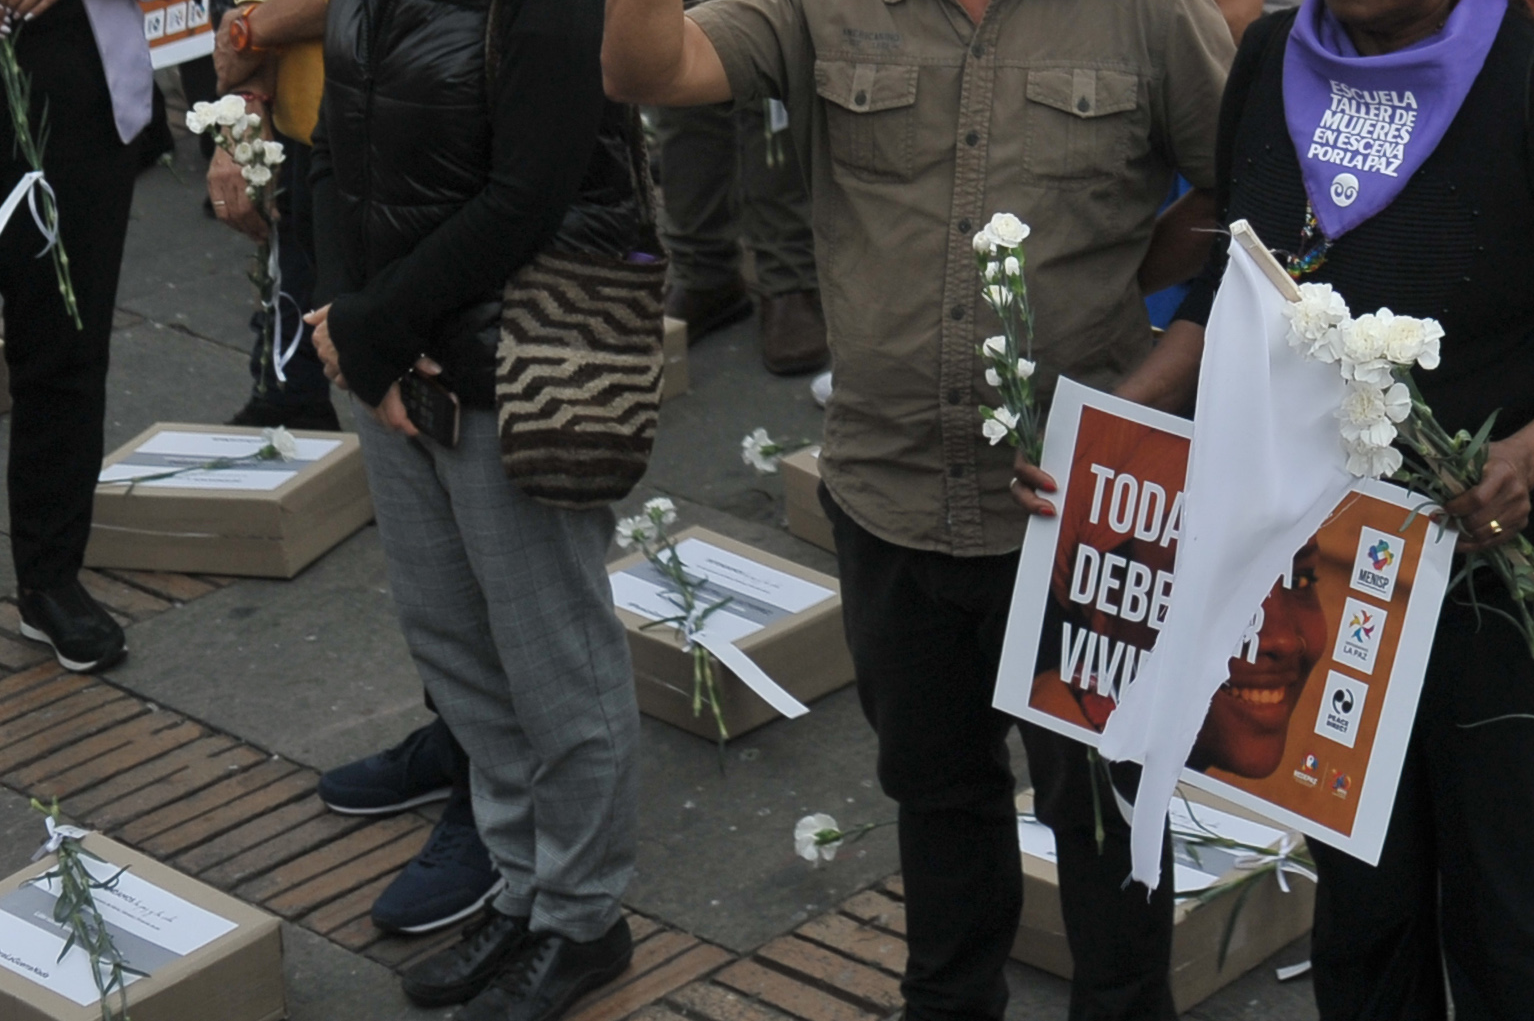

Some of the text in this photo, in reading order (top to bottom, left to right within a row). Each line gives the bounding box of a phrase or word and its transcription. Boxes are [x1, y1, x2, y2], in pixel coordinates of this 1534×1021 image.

[1329, 80, 1418, 109] ESCUELA
[1330, 93, 1417, 127] TALLER DE
[1320, 109, 1413, 144] MUJERES
[1313, 128, 1405, 161] EN ESCENA
[1089, 463, 1184, 548] TODA
[1069, 543, 1175, 630] DEBE
[1358, 569, 1390, 590] MENISP
[1060, 621, 1153, 705] VIVI
[1326, 720, 1348, 733] DIRECT
[1327, 713, 1349, 727] PEACE
